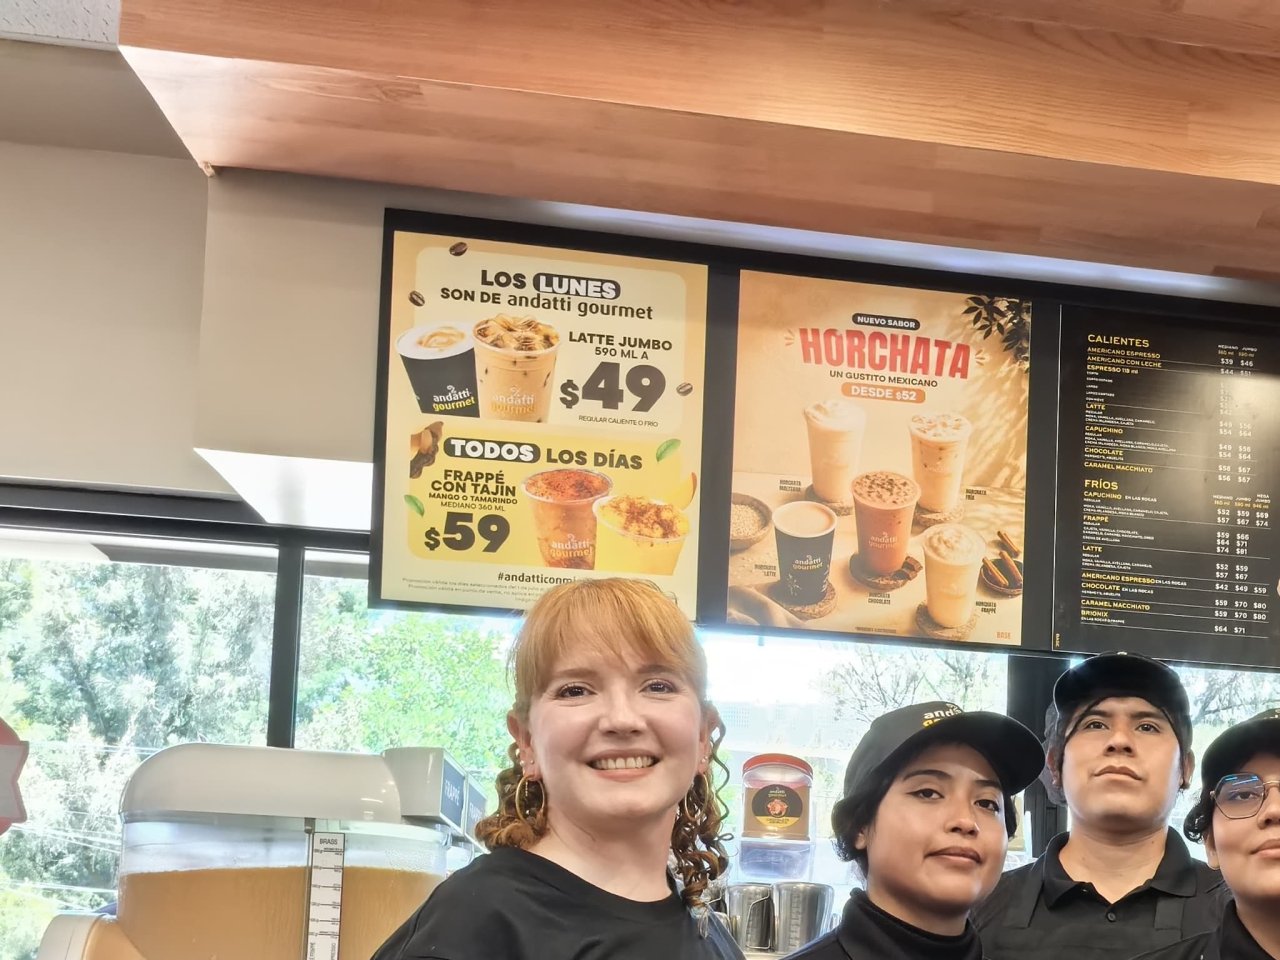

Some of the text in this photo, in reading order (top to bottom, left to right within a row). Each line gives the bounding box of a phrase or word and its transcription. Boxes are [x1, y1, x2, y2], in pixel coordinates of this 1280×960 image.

[481, 270, 616, 300] LOS LUNES
[440, 287, 653, 320] SON DE andatti gourmet
[857, 316, 916, 329] NUEVO SABOR
[568, 331, 673, 351] LATTE JUMBO
[1087, 334, 1150, 348] CALIENTES
[594, 346, 649, 360] 590 ML A
[799, 327, 971, 379] HORCHATA
[1087, 347, 1161, 359] AMERICANO ESPRESSO
[829, 370, 938, 388] UN GUSTITO MEXICANO
[559, 361, 667, 413] $49
[851, 385, 917, 400] DESDE $52
[432, 397, 476, 412] gourmet
[1085, 425, 1124, 434] CAPUCHINO
[450, 439, 643, 470] TODOS LOS DÍAS
[1084, 447, 1124, 456] CHOCOLATE
[1084, 461, 1153, 473] CARAMEL MACCHIATO
[443, 469, 505, 485] FRAPPÉ
[431, 480, 467, 493] CON
[1084, 479, 1119, 491] FRÍOS
[429, 492, 460, 501] MANGO
[470, 495, 518, 505] TAMARINDO
[1083, 491, 1122, 500] CAPUCHINO
[440, 501, 477, 510] MEDIANO
[478, 503, 493, 511] 360
[424, 511, 511, 553] $59
[498, 571, 575, 586] #andatticonm
[1081, 572, 1155, 584] AMERICANO ESPRESSO
[1215, 583, 1267, 594] $42 $49 $59
[1081, 609, 1109, 618] BRIONIX
